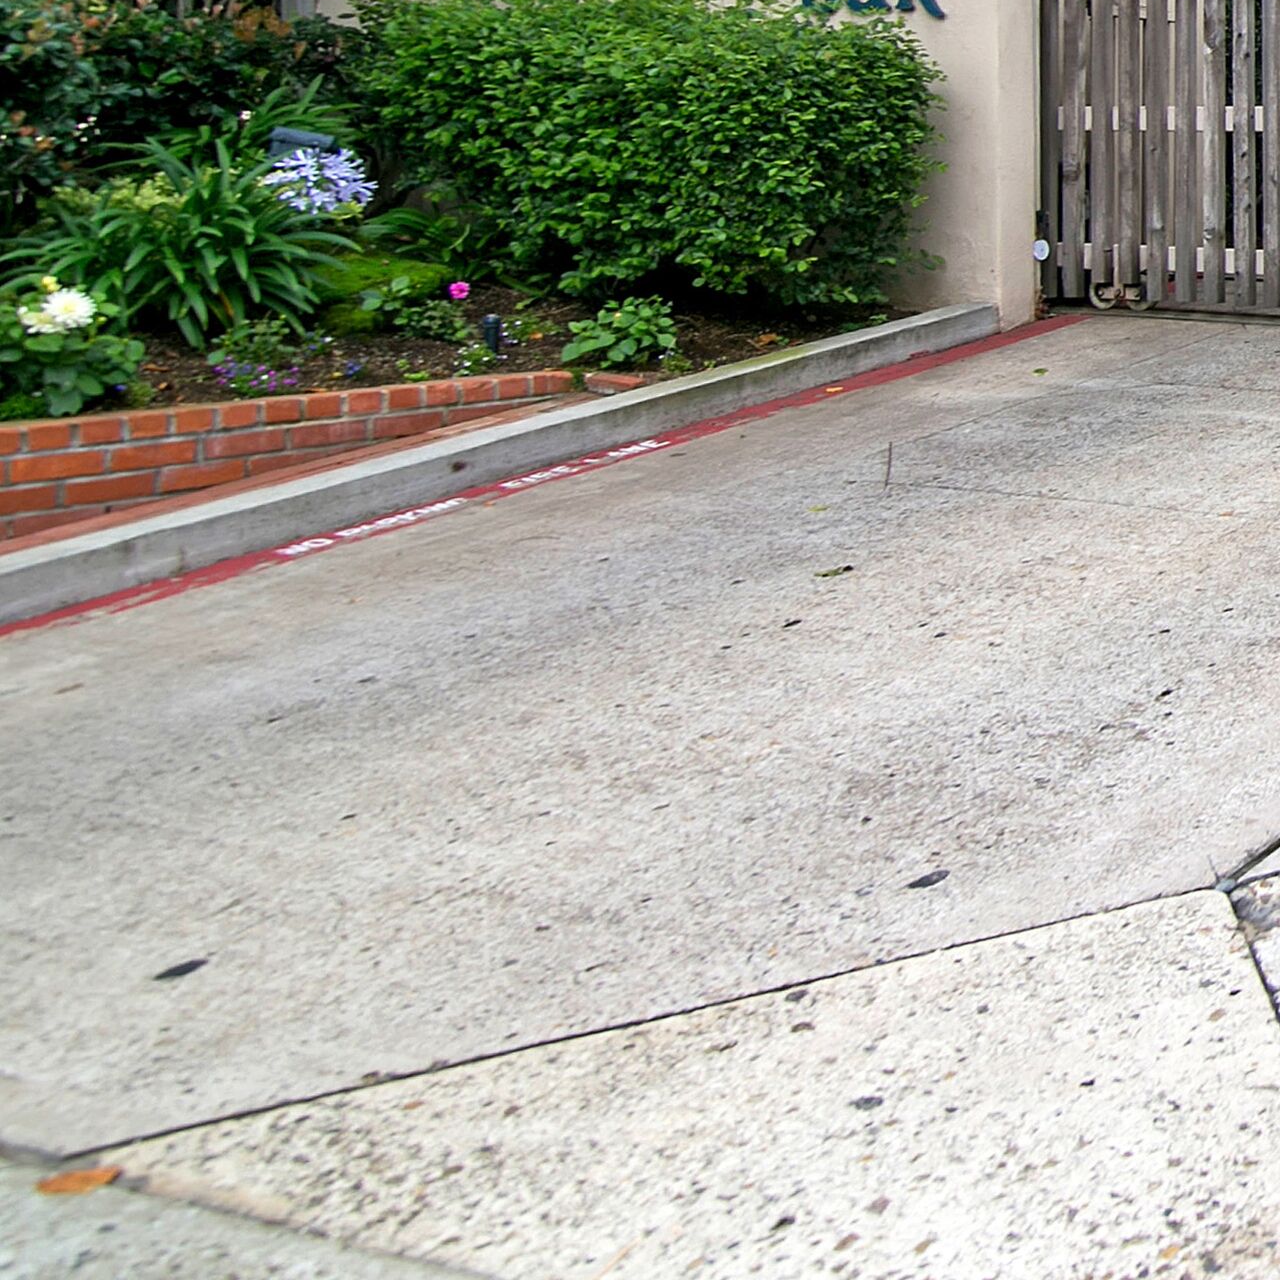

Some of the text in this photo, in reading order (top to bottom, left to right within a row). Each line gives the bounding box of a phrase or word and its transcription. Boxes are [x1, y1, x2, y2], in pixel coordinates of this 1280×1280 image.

[276, 537, 333, 557] NO
[501, 464, 580, 490] FIRE
[584, 437, 671, 465] LANE
